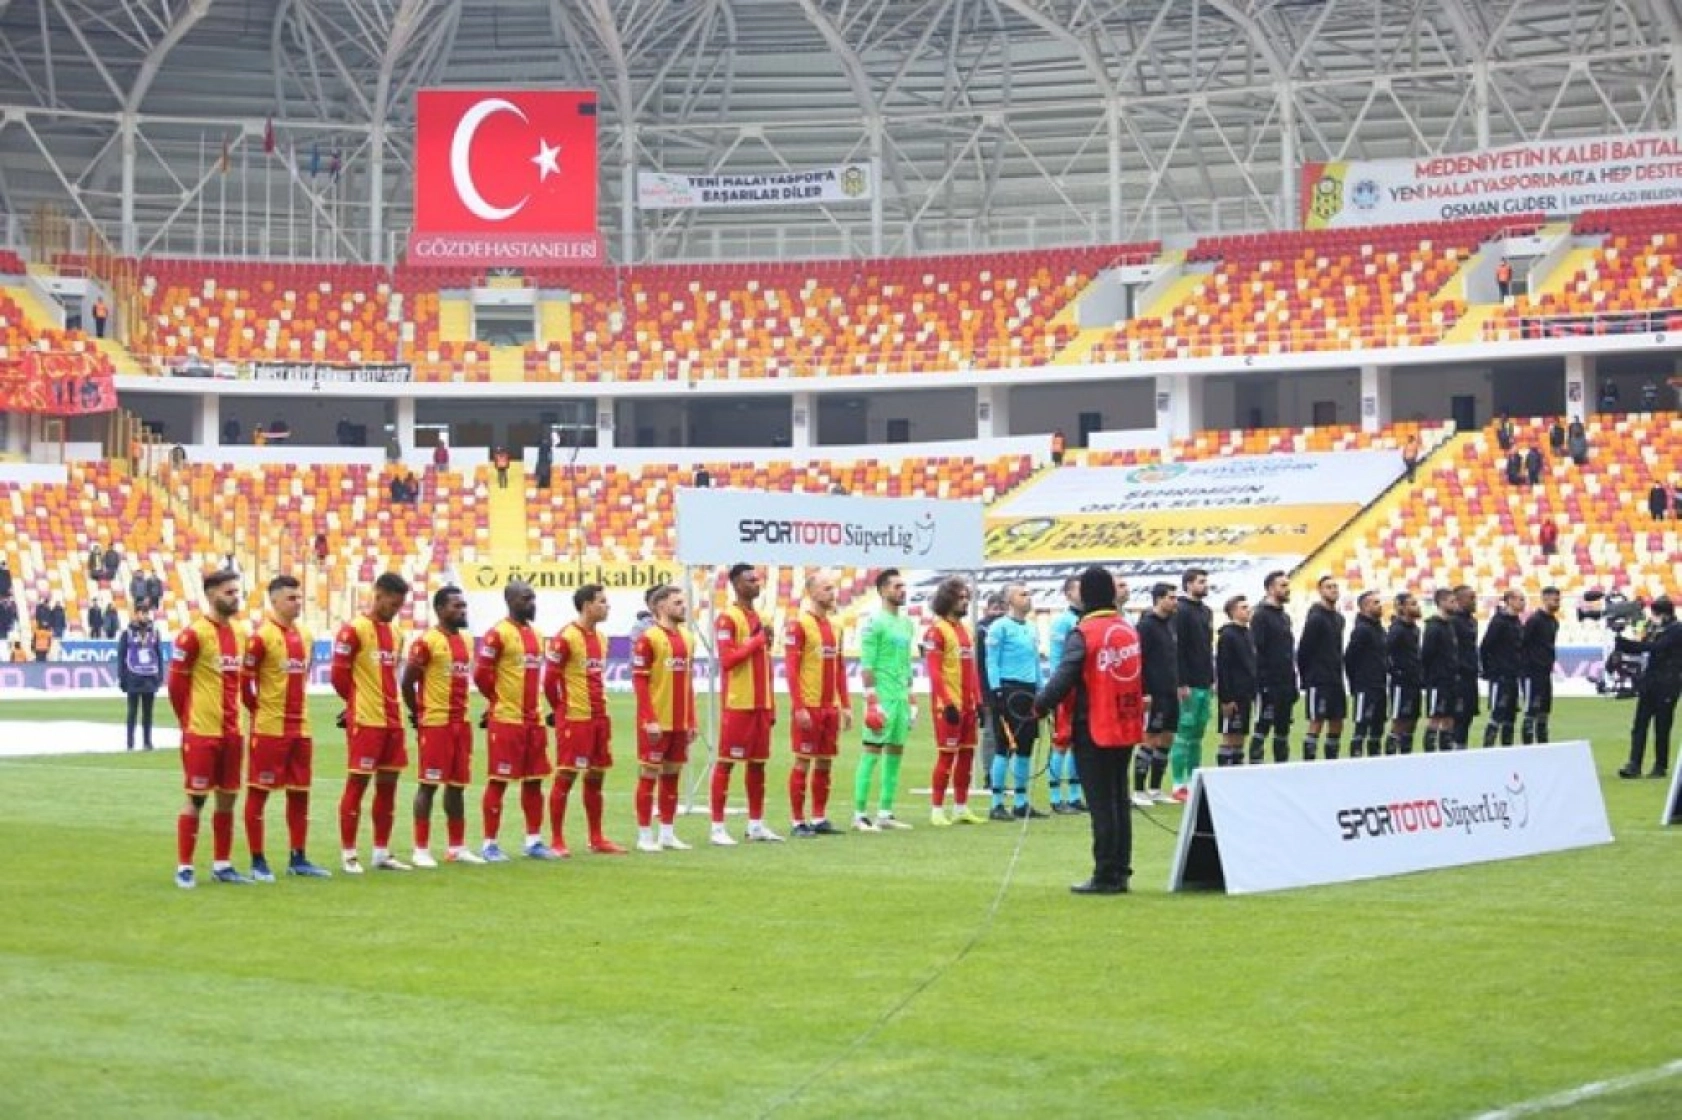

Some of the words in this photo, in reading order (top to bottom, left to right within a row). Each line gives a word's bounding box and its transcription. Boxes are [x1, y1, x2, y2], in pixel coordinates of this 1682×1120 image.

[1415, 147, 1544, 178] MEDENİYETİN
[1549, 142, 1607, 165] KALBİ
[1600, 165, 1632, 184] HEP
[702, 188, 780, 203] BAŞARILAR
[783, 184, 823, 199] DİLER
[1441, 200, 1500, 219] OSMAN
[739, 519, 842, 545] SPORTOTO
[844, 522, 913, 553] SüperLig
[507, 566, 589, 587] öznur
[596, 565, 673, 587] kablo
[1336, 799, 1443, 841] SPORTOTO
[1441, 793, 1512, 834] SüperLig
